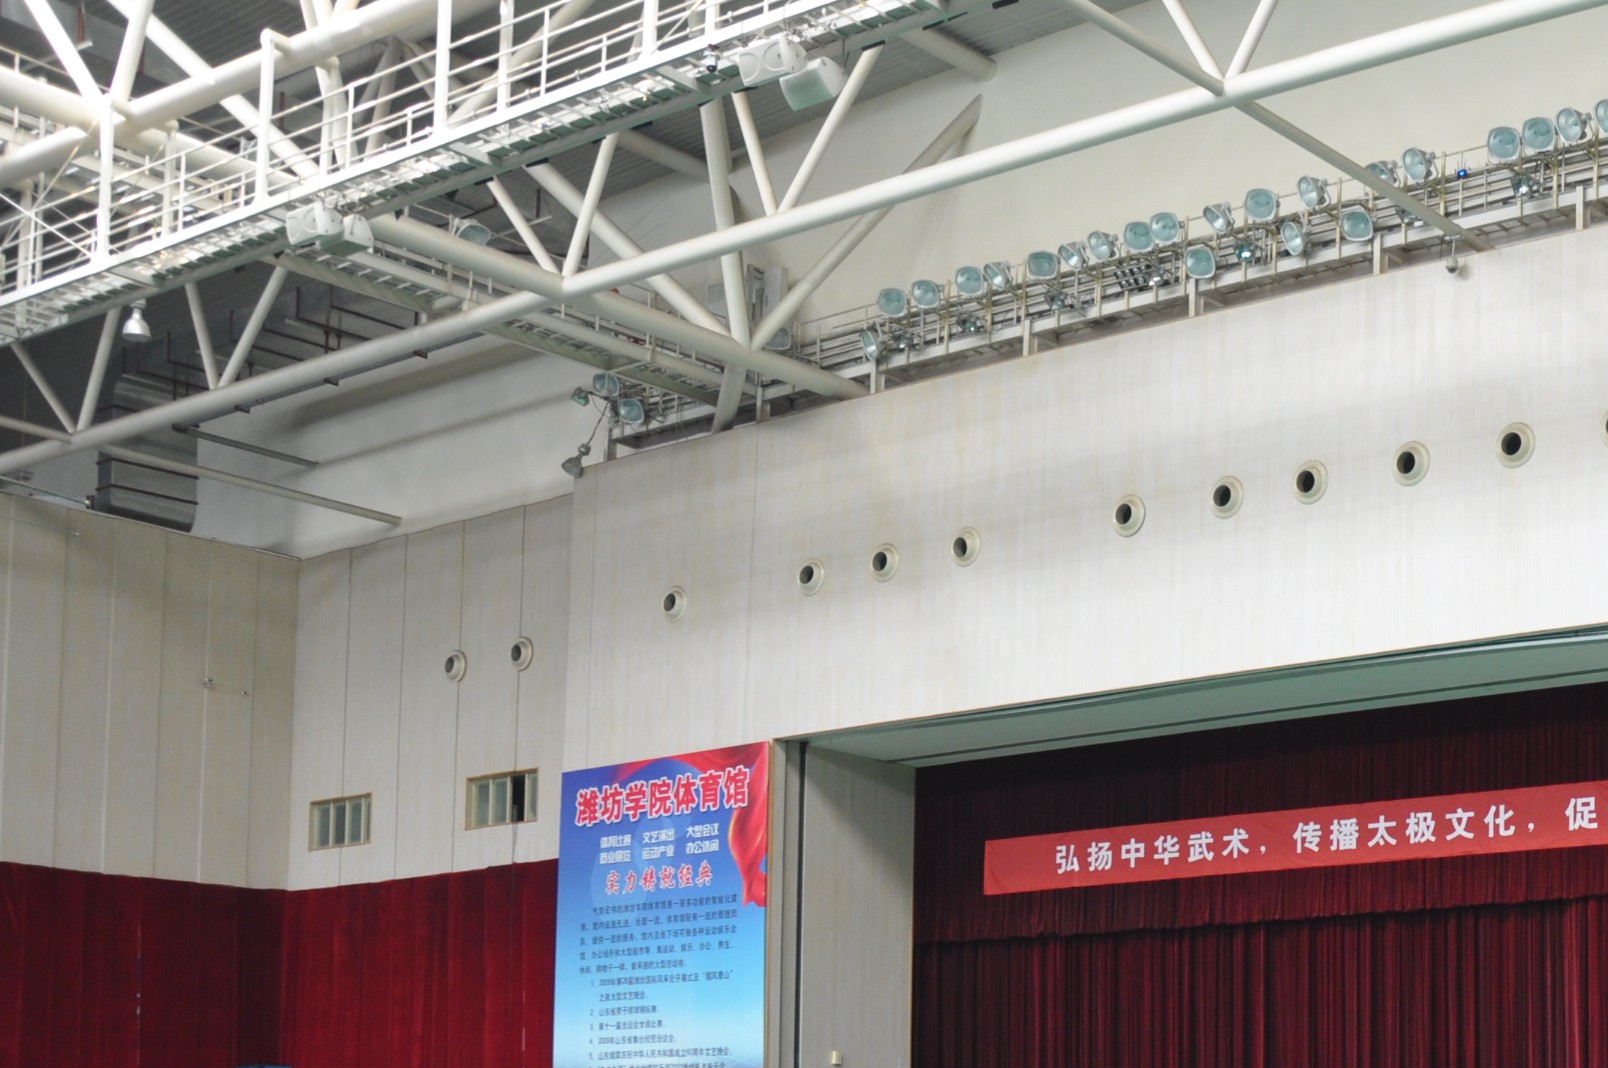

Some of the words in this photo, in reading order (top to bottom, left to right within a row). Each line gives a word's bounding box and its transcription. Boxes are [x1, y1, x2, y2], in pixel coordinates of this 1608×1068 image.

[575, 765, 749, 827] 潍坊学院体育馆
[686, 823, 719, 837] 大型会议
[605, 860, 713, 895] 实力铸就经典
